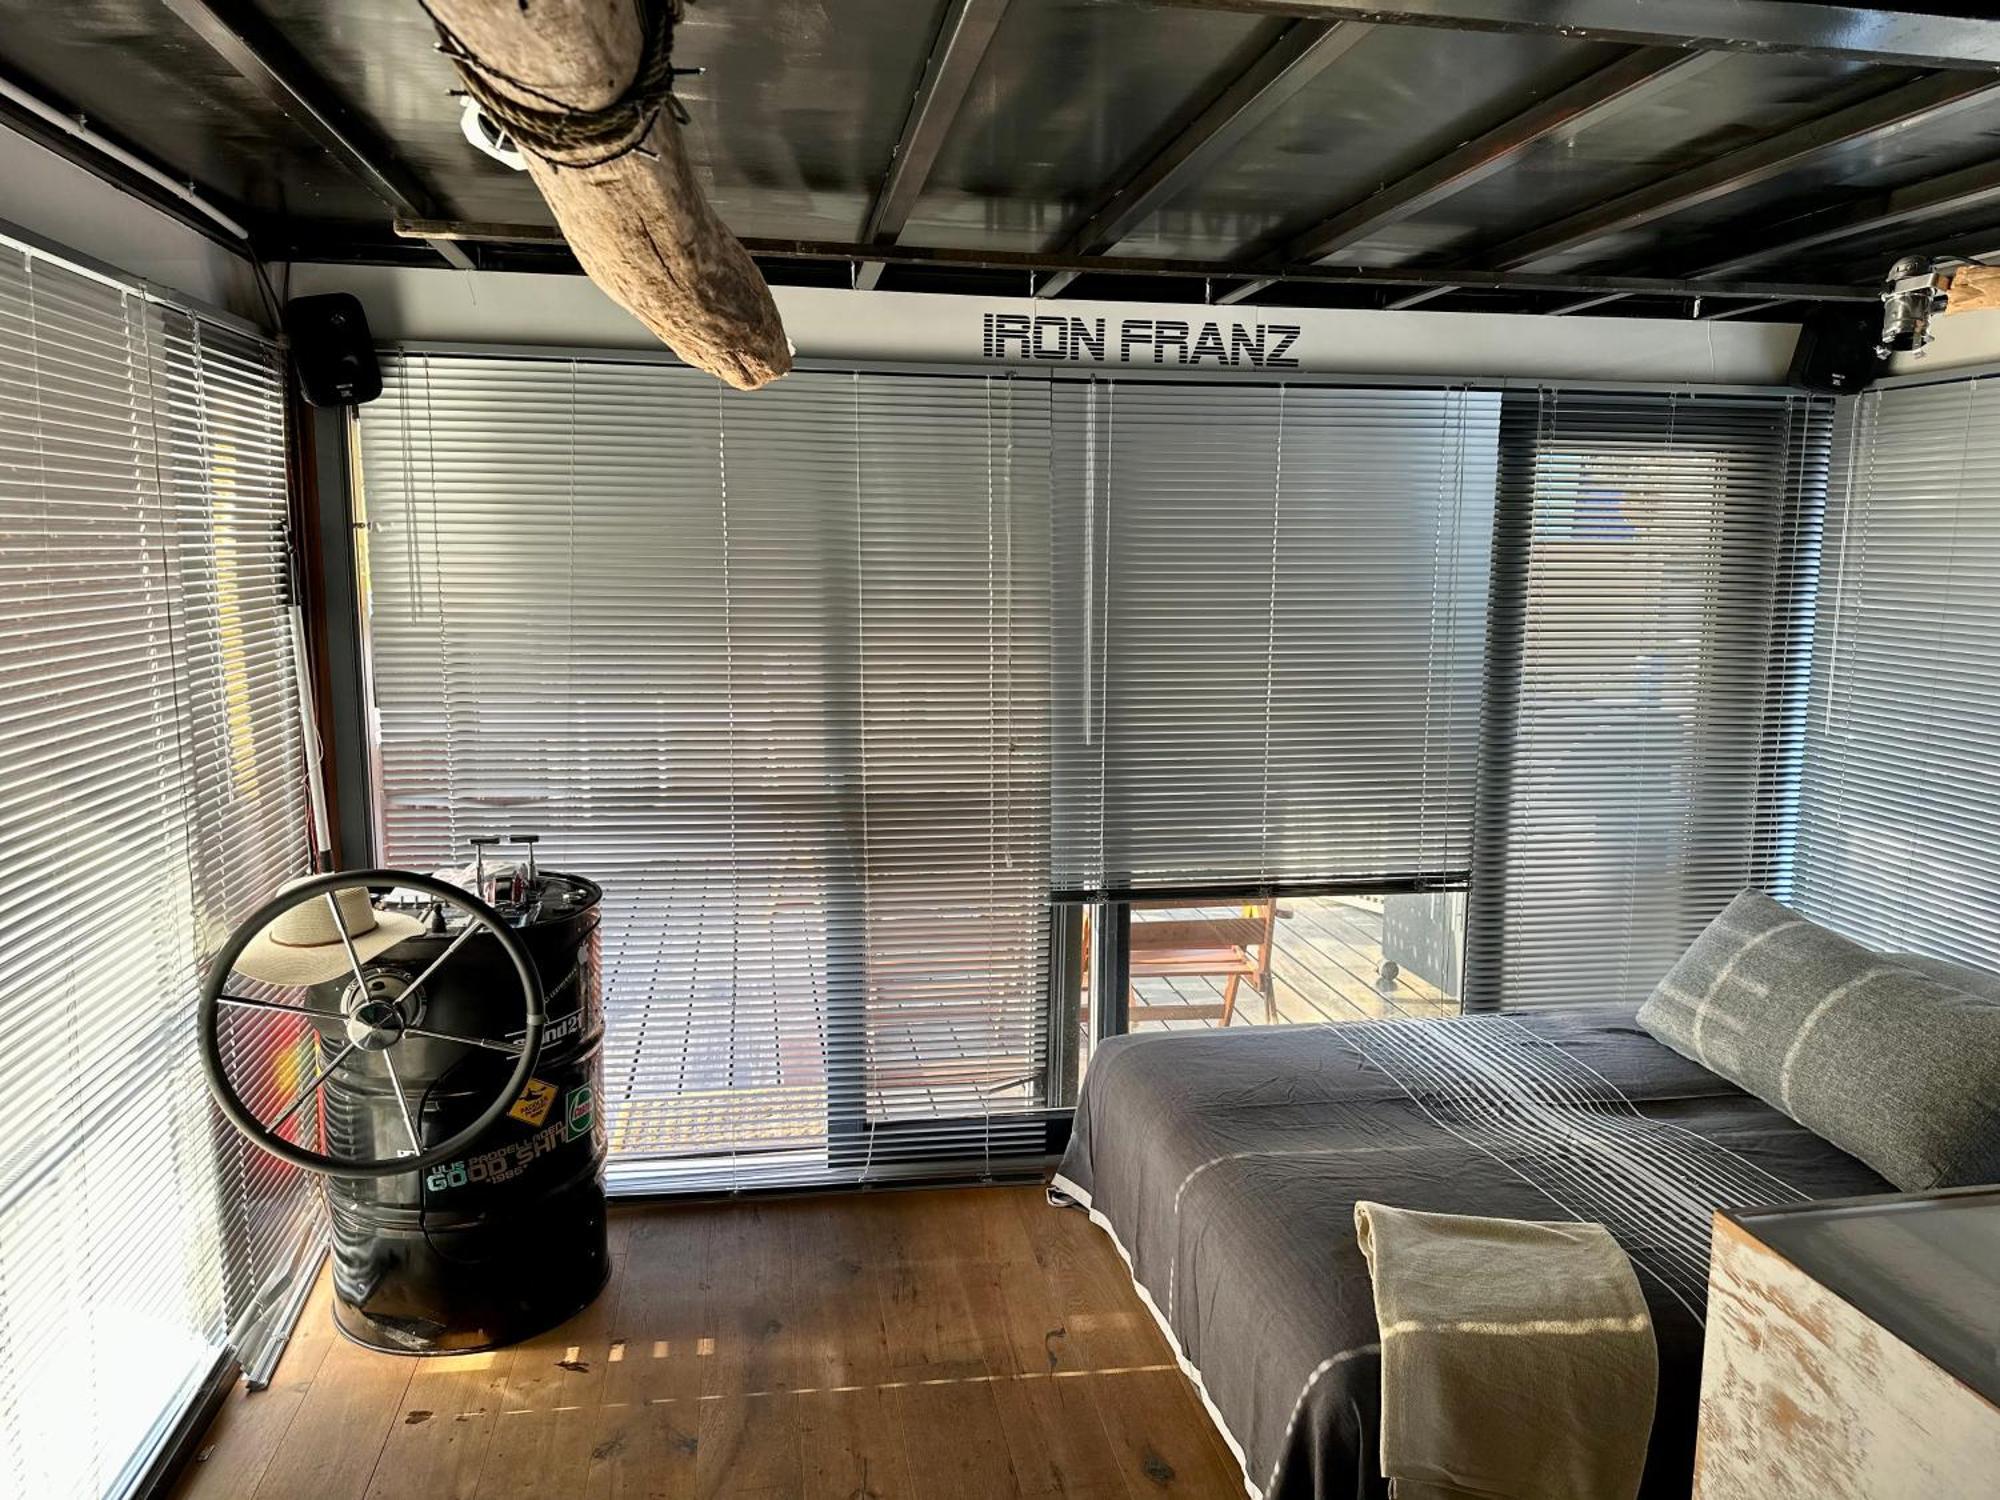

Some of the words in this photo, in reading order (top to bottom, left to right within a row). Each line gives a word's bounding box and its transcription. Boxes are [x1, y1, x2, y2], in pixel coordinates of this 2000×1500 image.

[984, 313, 1105, 361] IRON
[1121, 319, 1300, 367] FRANZ
[426, 1157, 508, 1192] GOOD
